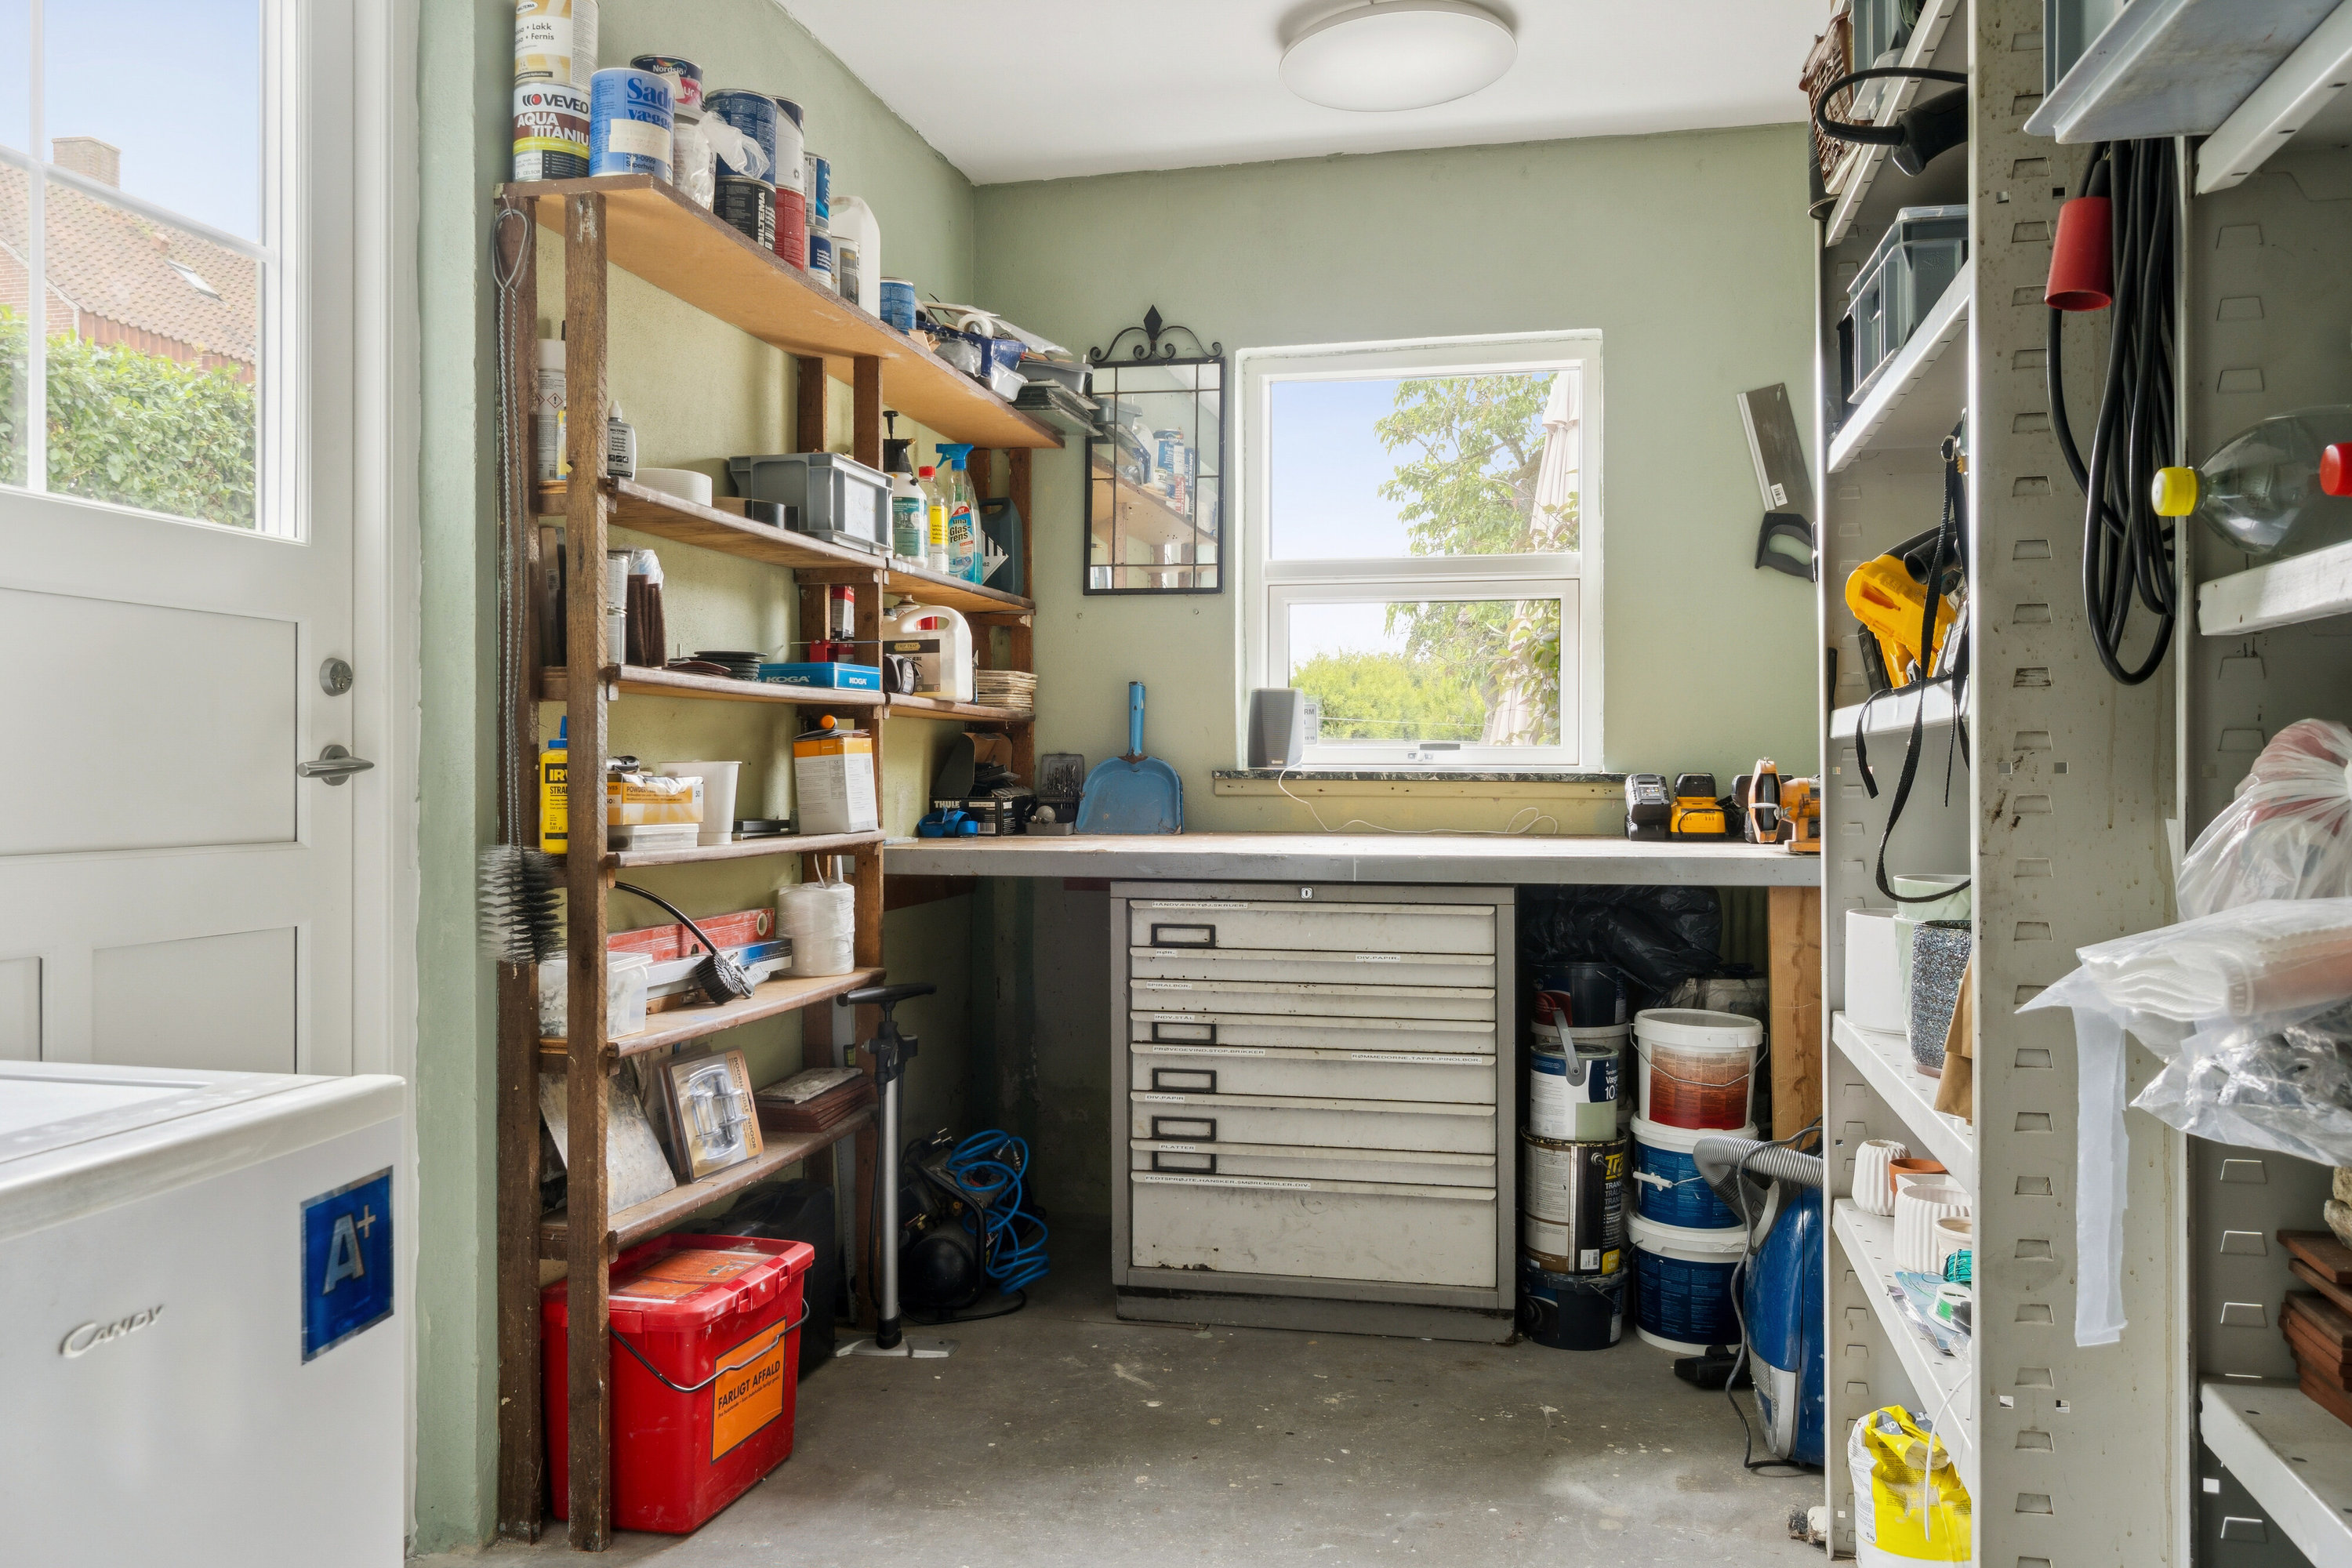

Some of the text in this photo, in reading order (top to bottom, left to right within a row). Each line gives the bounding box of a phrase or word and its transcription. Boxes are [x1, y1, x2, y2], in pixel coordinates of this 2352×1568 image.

[532, 22, 552, 31] Lakk
[517, 112, 559, 128] AQUA
[532, 125, 590, 147] TITANIU
[949, 525, 971, 536] Glas-
[949, 532, 968, 543] rens
[849, 677, 866, 685] KOGA
[1605, 1085, 1615, 1100] 10
[733, 1056, 757, 1149] DOORHNDLE NDOOR
[322, 1203, 376, 1296] A+
[718, 1360, 780, 1410] FARLIGT AFFALD
